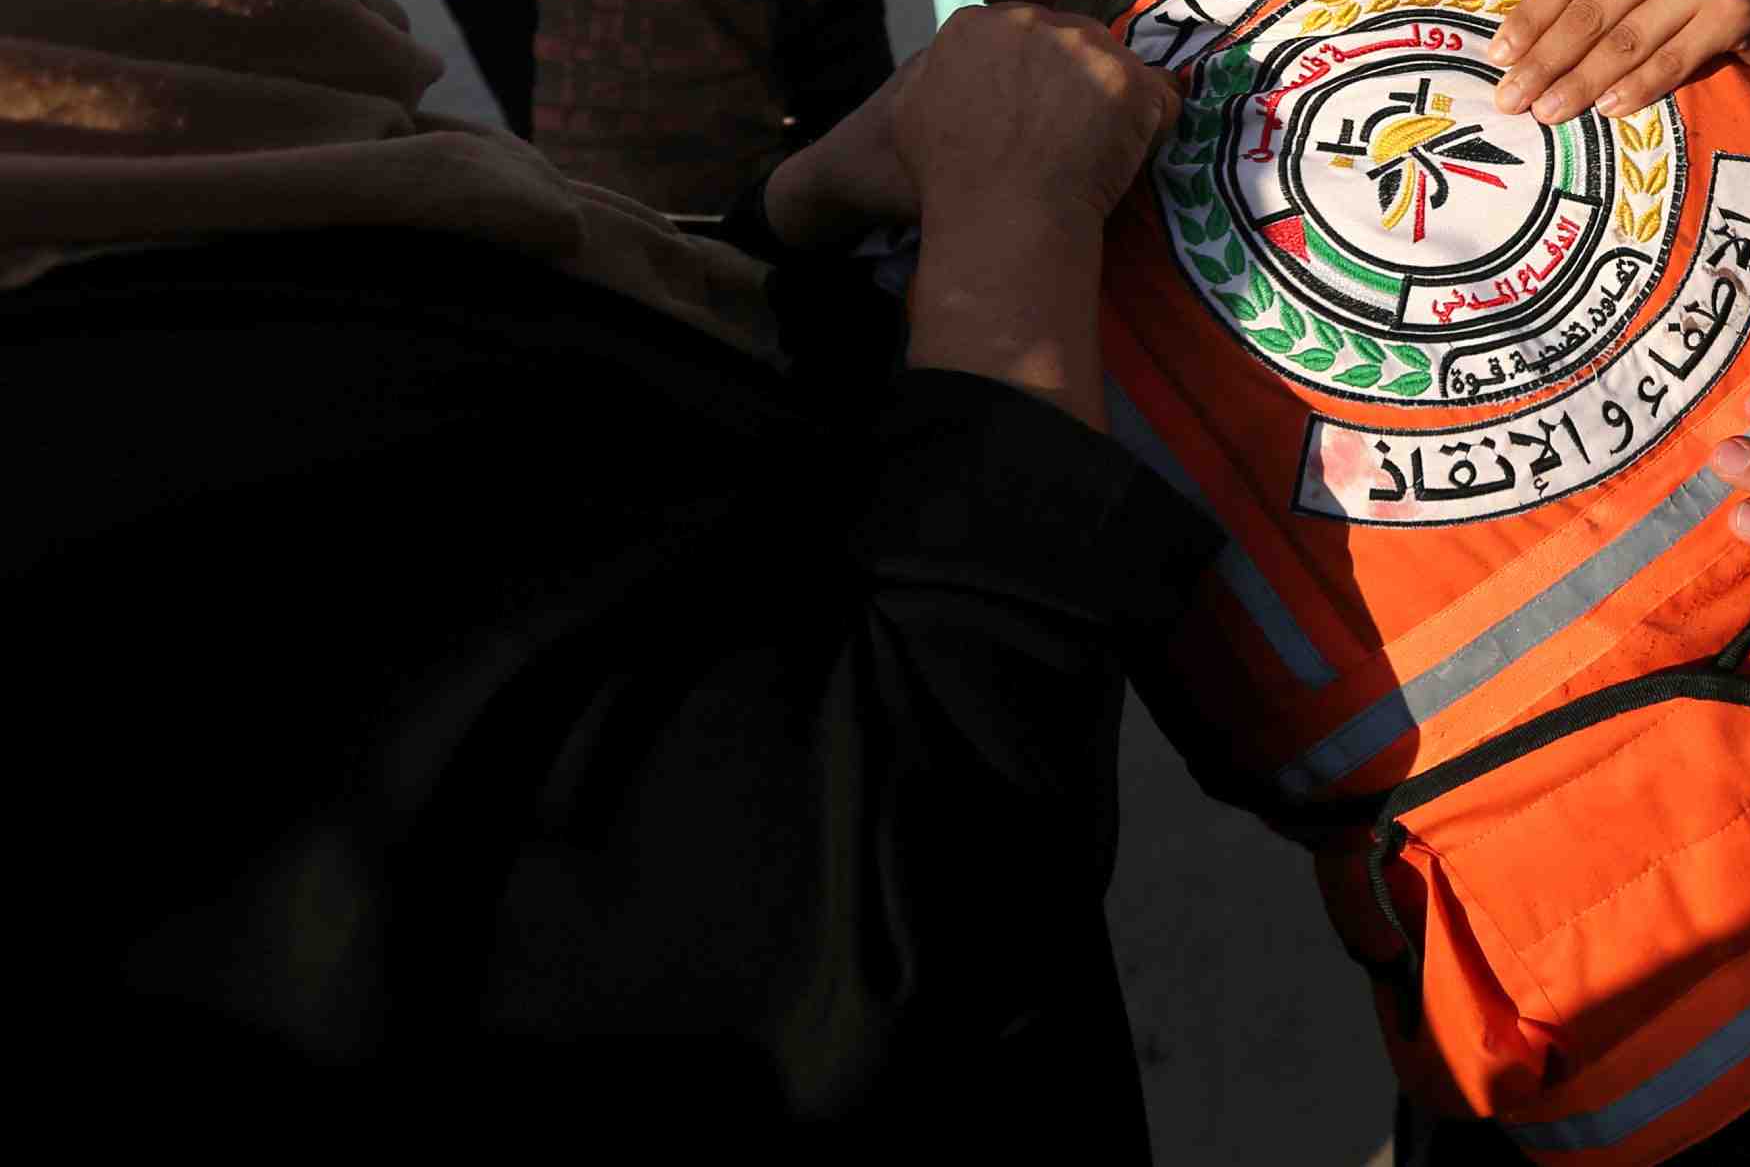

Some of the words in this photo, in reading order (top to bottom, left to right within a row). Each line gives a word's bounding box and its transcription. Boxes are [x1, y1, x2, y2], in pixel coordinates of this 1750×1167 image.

[1319, 23, 1464, 63] دولة
[1517, 215, 1581, 296] الدفاع
[1431, 277, 1519, 324] المدني
[1450, 356, 1506, 395] قوة
